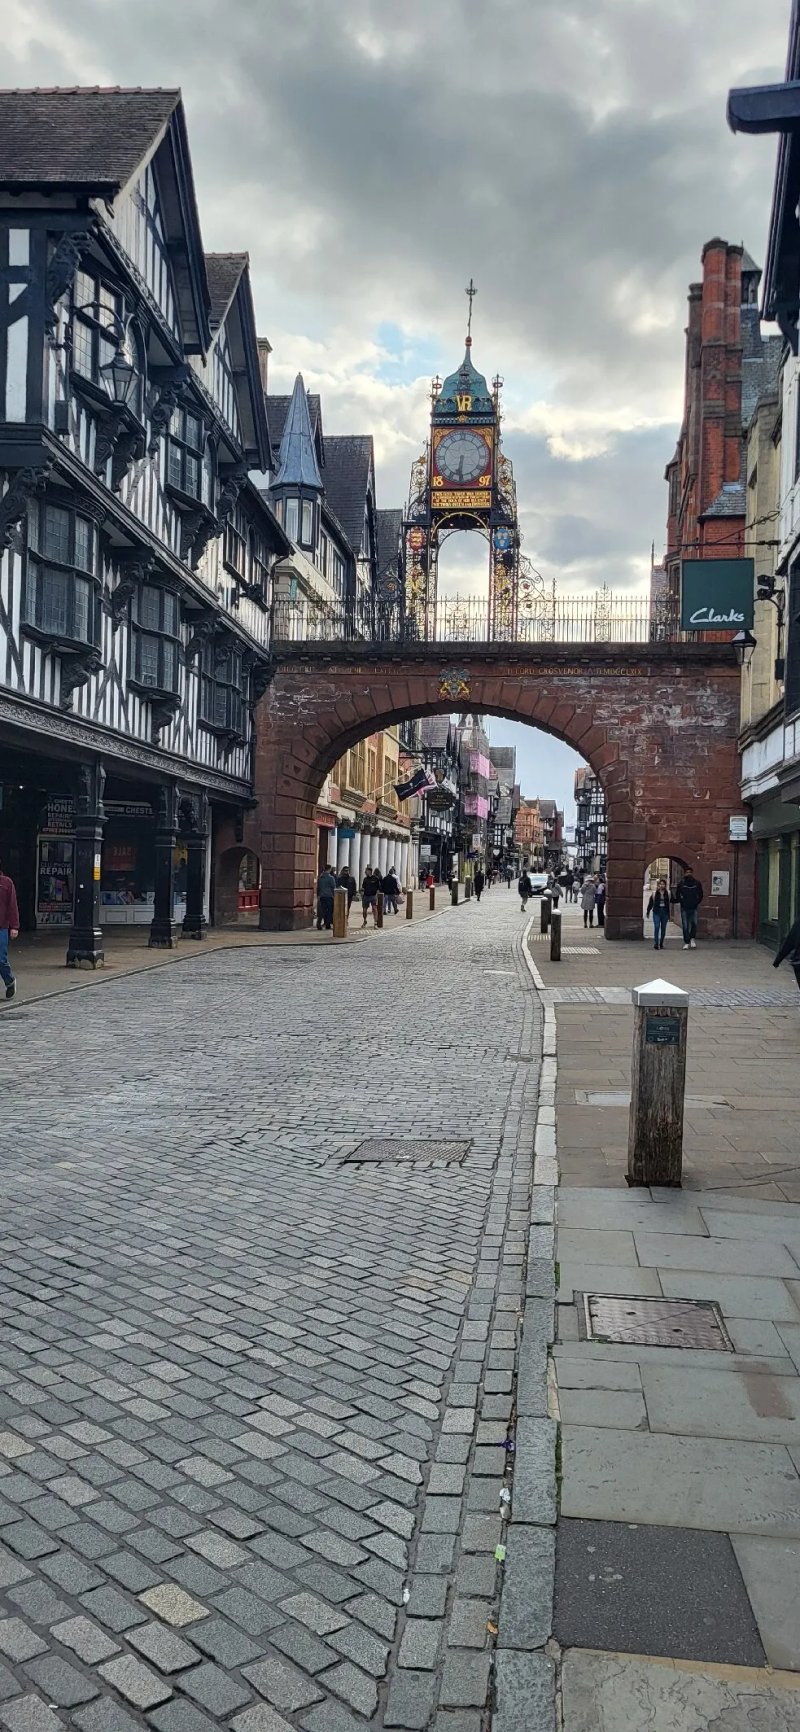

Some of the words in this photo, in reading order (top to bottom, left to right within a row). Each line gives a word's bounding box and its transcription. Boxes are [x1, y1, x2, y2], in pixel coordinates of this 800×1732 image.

[432, 475, 444, 487] 18
[478, 475, 491, 487] 97
[689, 607, 745, 624] Clarks
[40, 867, 73, 876] REPAIR
